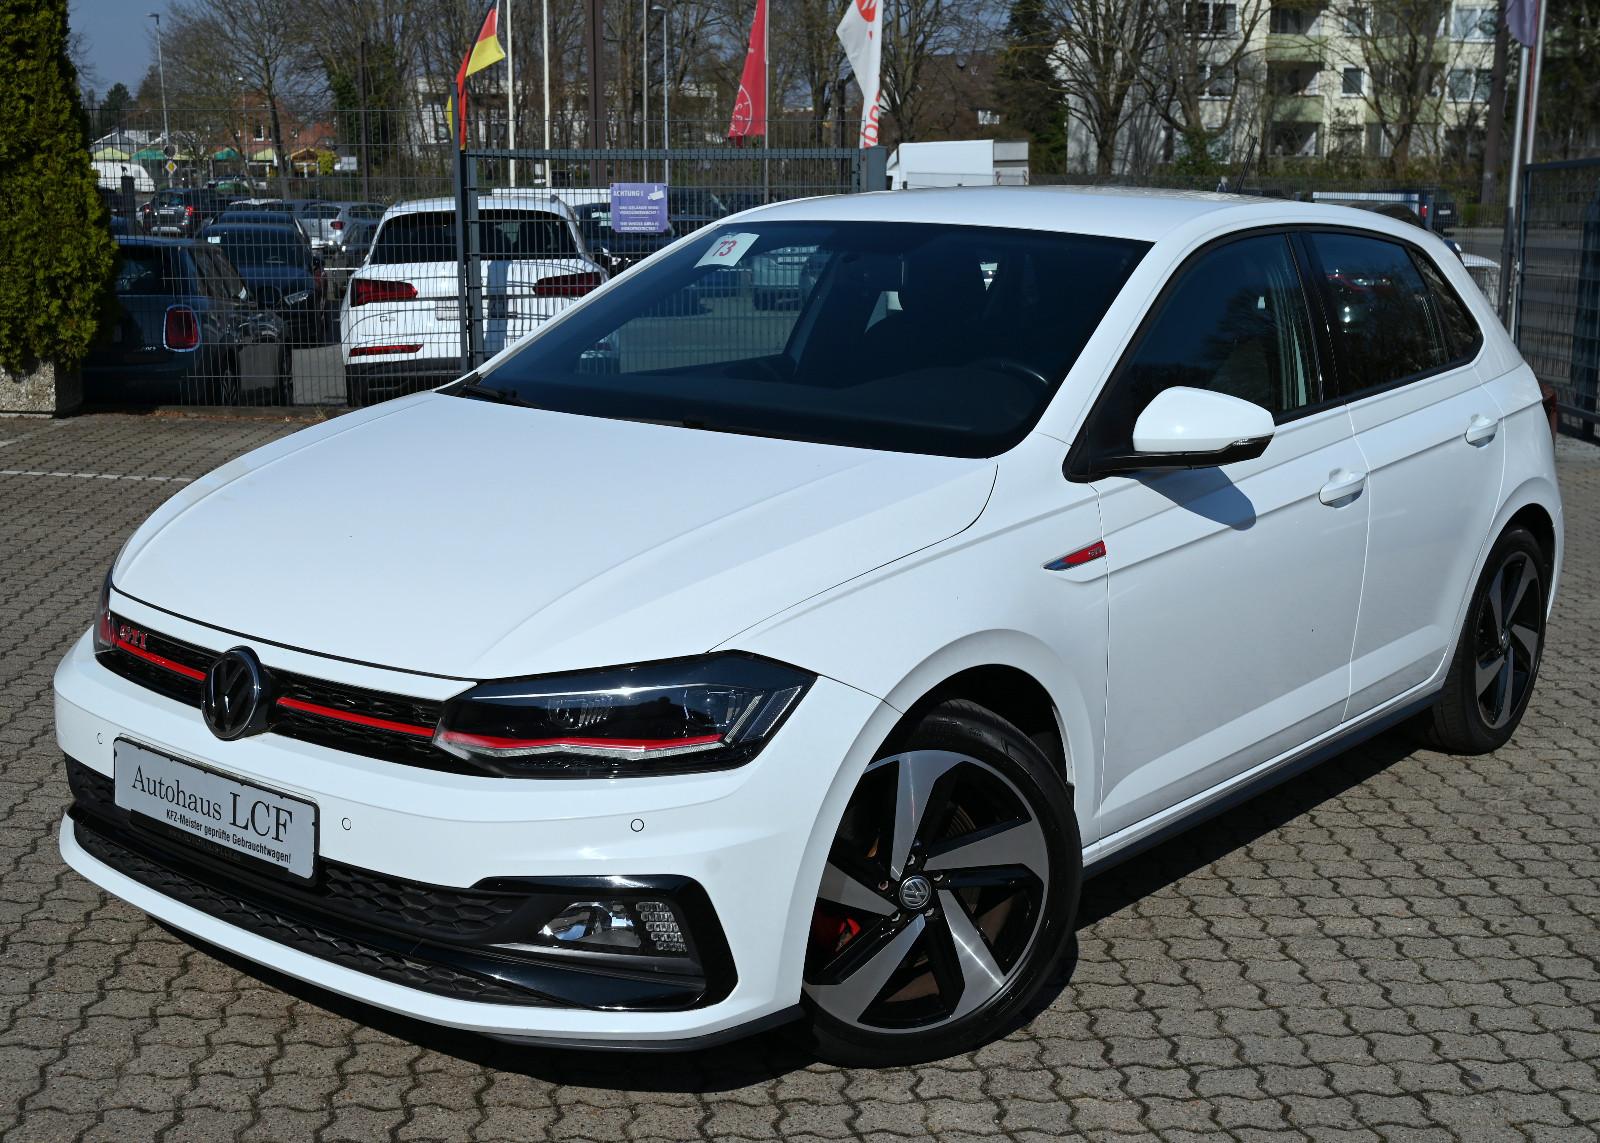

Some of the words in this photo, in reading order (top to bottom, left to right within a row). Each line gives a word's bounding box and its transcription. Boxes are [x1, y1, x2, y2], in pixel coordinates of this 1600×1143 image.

[712, 239, 738, 257] 73
[119, 624, 147, 649] GTI
[131, 765, 222, 821] Autohaus
[229, 792, 293, 842] LCF
[166, 808, 203, 832] KFZ-Meister
[204, 825, 231, 844] geprüfte
[232, 833, 291, 864] Gebrauchtwagen!
